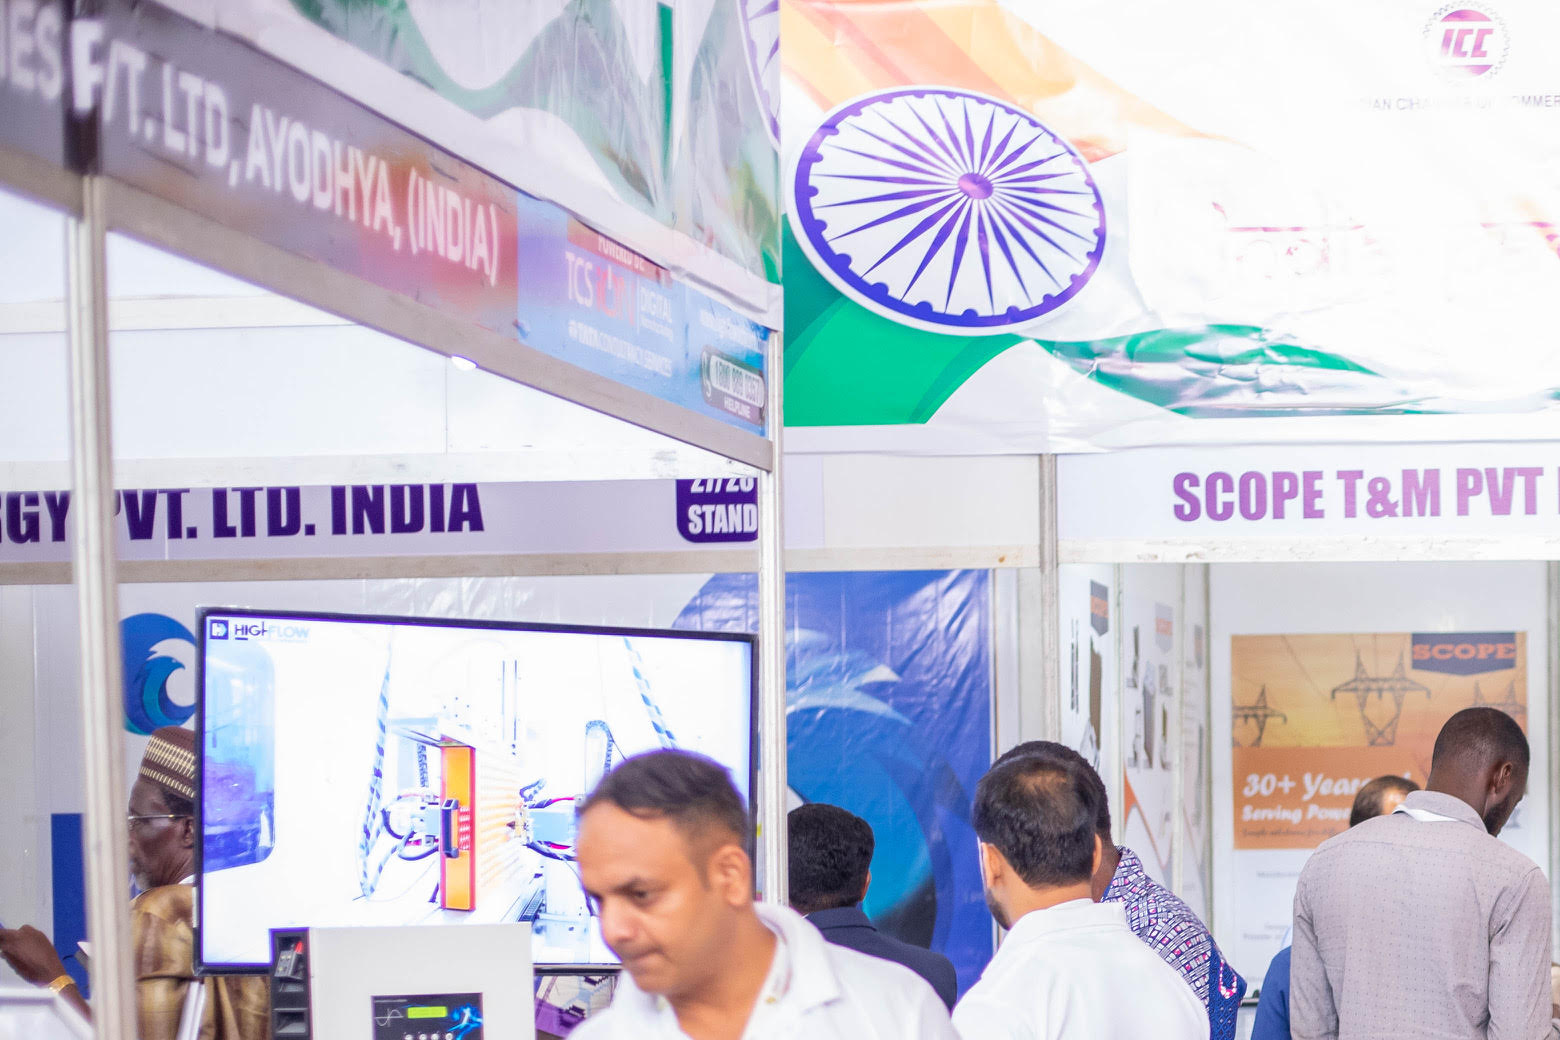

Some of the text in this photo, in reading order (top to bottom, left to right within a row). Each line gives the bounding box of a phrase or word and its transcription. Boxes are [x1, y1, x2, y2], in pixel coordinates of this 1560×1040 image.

[1441, 29, 1494, 57] ICC
[408, 165, 499, 287] (INDIA)
[565, 250, 594, 308] TCS
[1173, 470, 1325, 522] SCOPE
[1337, 468, 1441, 518] T&M
[1456, 466, 1544, 516] PVT
[211, 486, 316, 539] LTD.
[331, 482, 485, 536] INDIA
[687, 503, 758, 535] STAND
[1412, 643, 1517, 661] SCOPE
[1242, 772, 1297, 798] 30+
[1242, 804, 1303, 825] Serving
